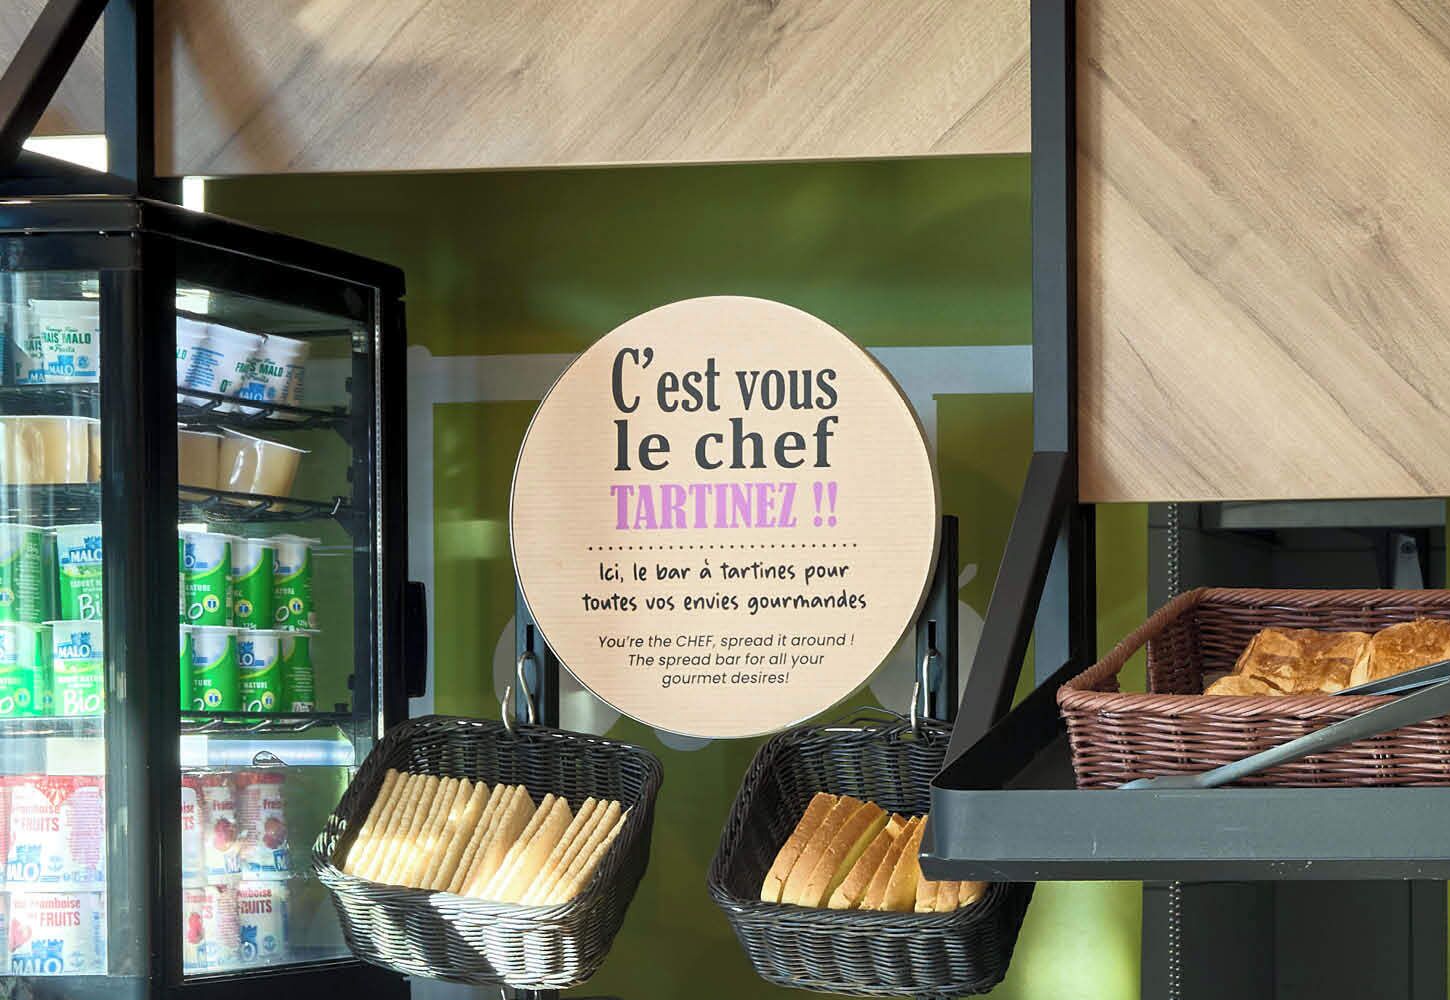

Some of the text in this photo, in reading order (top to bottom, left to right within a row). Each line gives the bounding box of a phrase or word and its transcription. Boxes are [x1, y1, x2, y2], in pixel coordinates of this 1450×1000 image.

[63, 332, 91, 344] MALO
[611, 347, 838, 414] C'est vous
[614, 415, 839, 471] le chef
[610, 480, 839, 530] TARTINEZ !!
[599, 558, 849, 585] Ici, le bar à tartines pour
[582, 589, 867, 616] toutes vos envies gourmandes
[598, 635, 644, 648] You're
[649, 635, 672, 648] the
[676, 635, 716, 649] CHEF,
[720, 635, 774, 650] spread
[778, 635, 787, 647] it
[791, 634, 846, 647] around
[57, 645, 91, 658] MALO
[629, 653, 825, 669] The spread bar for all your
[662, 672, 789, 688] gourmet desires!
[40, 911, 81, 927] FRUITS
